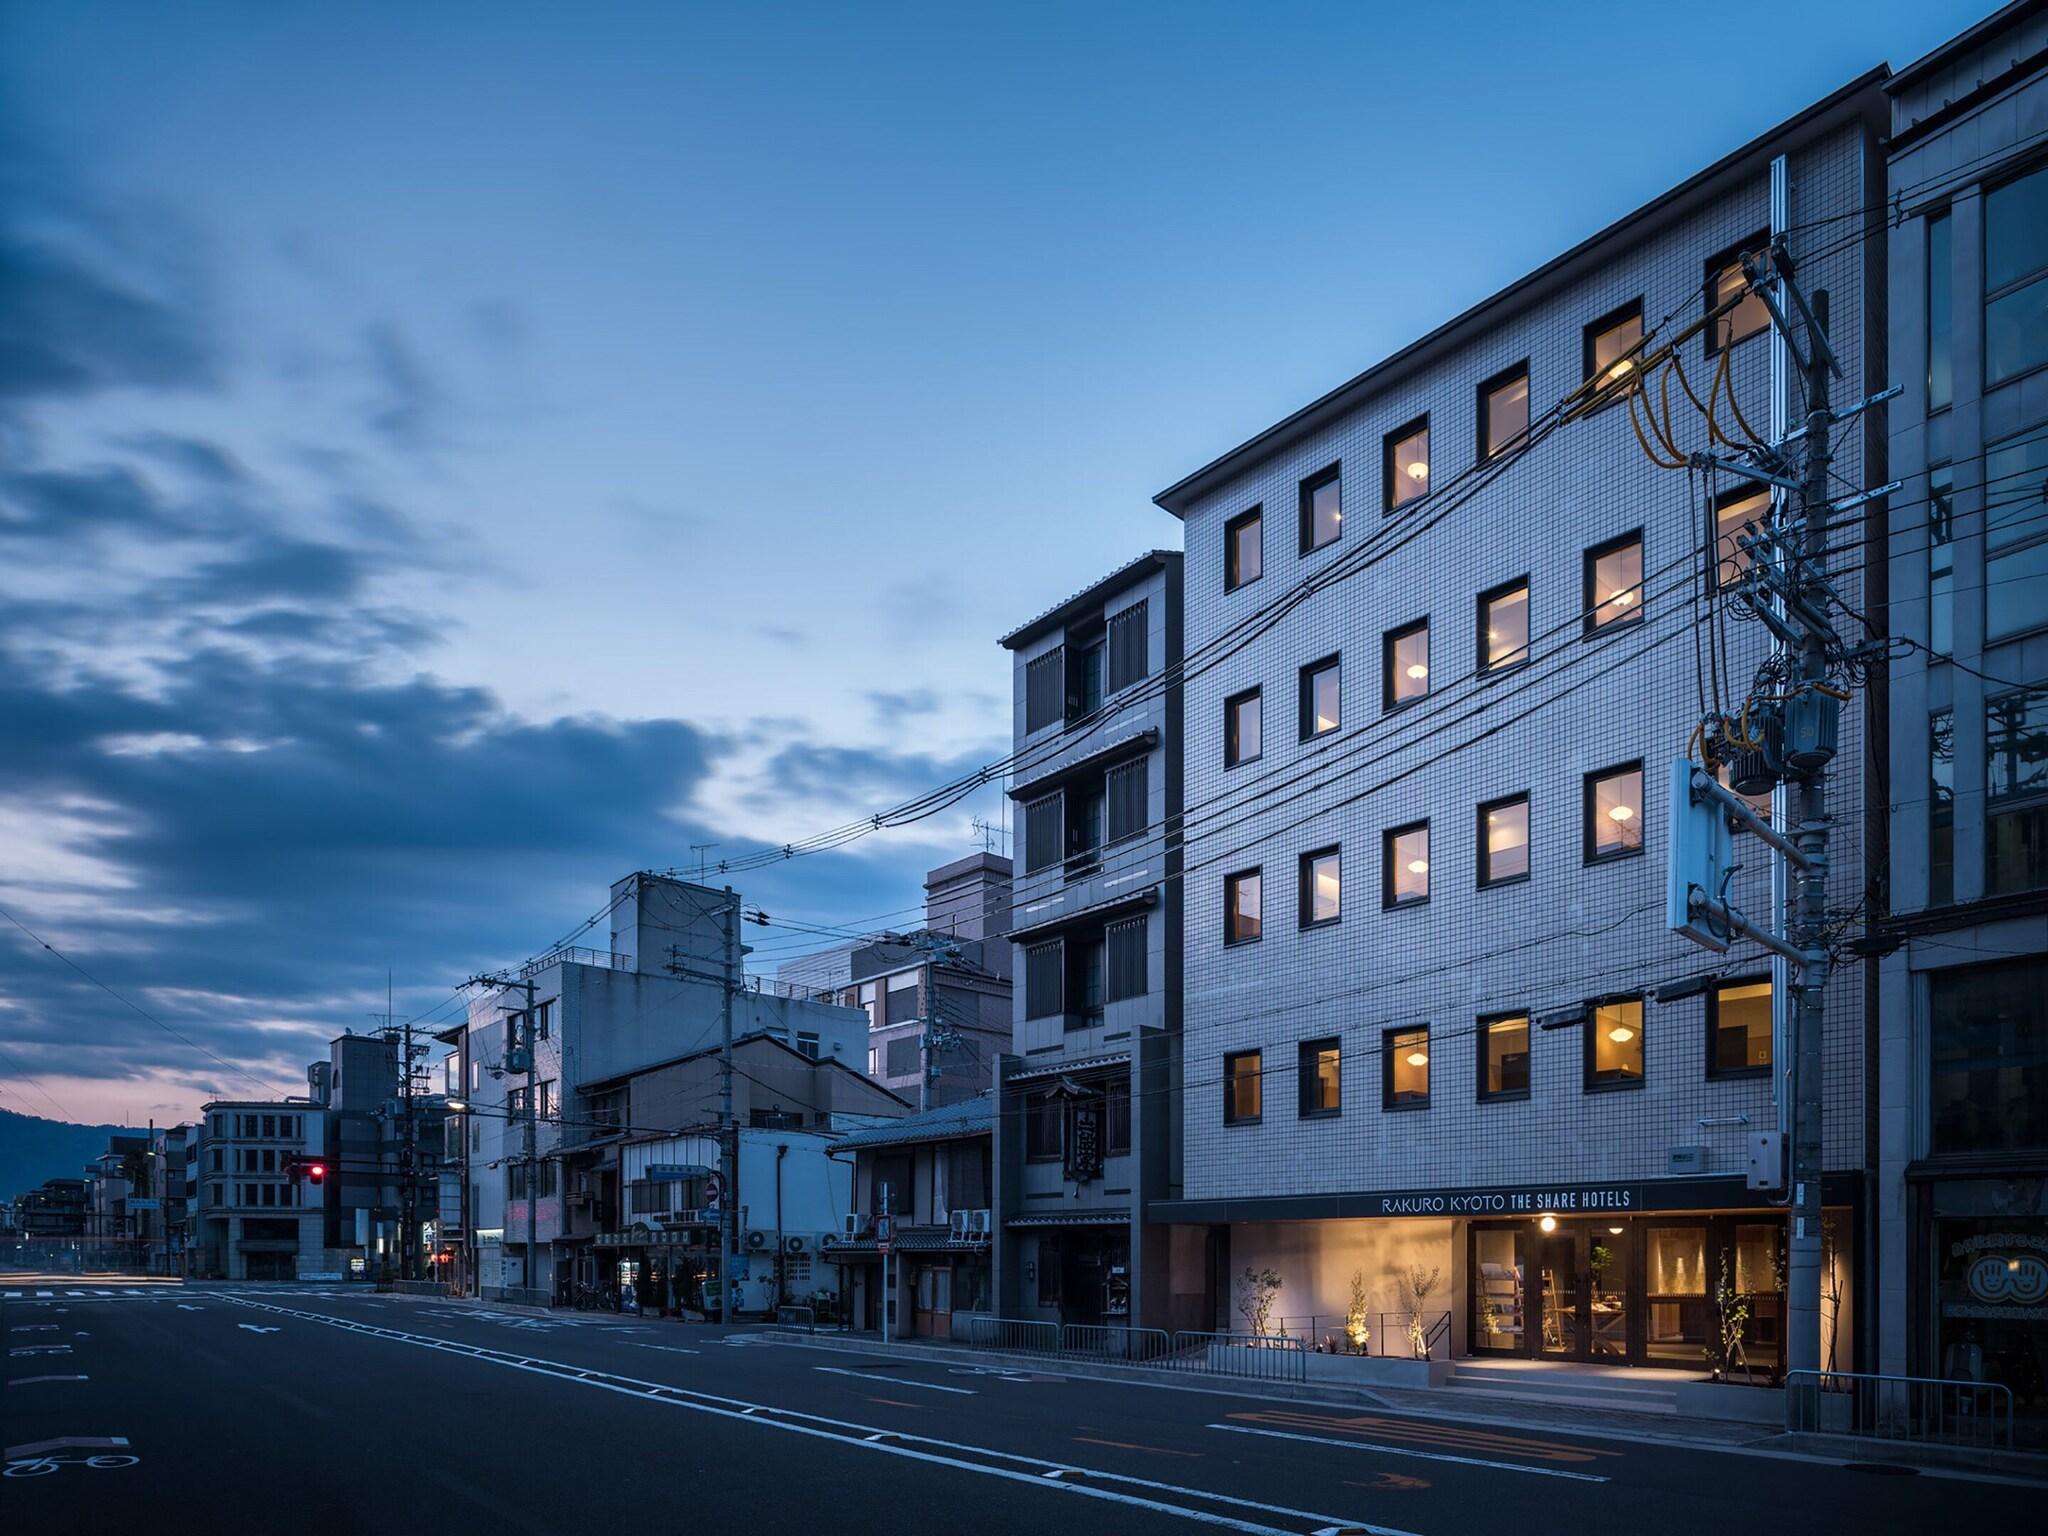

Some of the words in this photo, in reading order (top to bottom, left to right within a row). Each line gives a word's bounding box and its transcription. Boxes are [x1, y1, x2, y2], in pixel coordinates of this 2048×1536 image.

[1382, 1197, 1444, 1212] RAKURO
[1450, 1195, 1505, 1211] KYOTO
[1511, 1194, 1531, 1209] THE
[1537, 1192, 1576, 1208] SHARE
[1582, 1190, 1630, 1207] HOTELS
